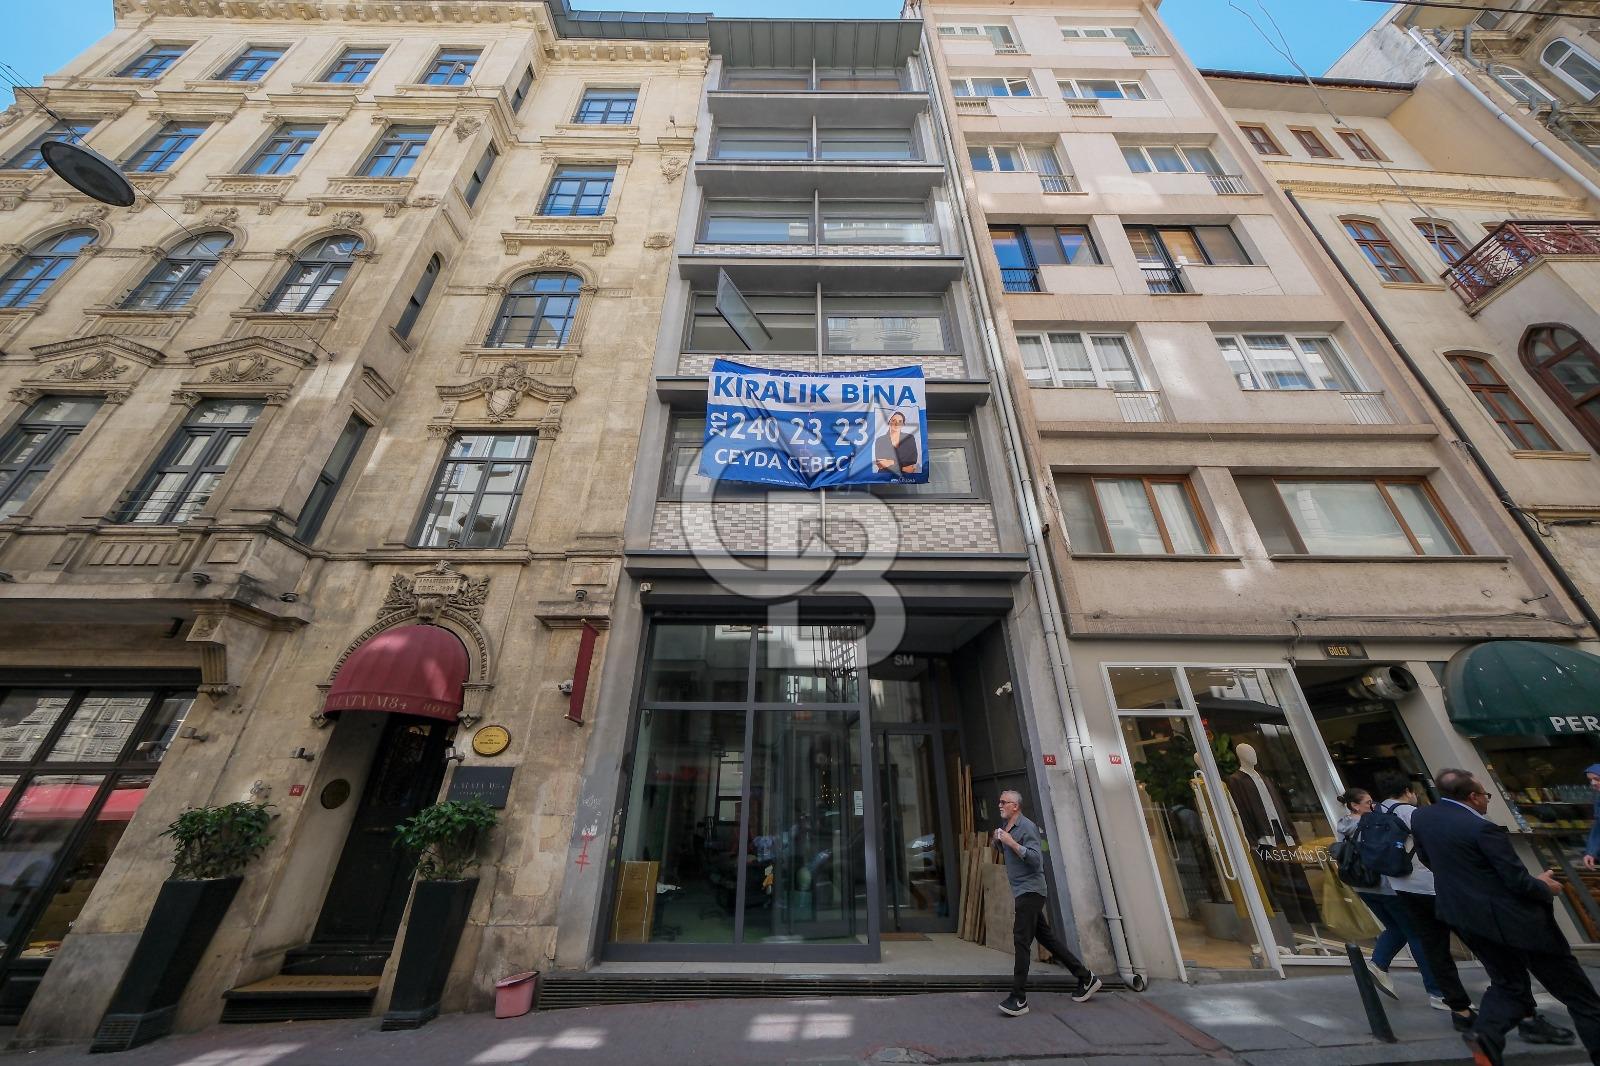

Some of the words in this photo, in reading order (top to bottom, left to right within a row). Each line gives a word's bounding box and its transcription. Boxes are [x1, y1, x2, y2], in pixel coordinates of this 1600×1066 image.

[713, 375, 830, 403] KIRALIK
[841, 379, 917, 406] BİNA
[709, 411, 728, 438] 212
[730, 412, 780, 443] 240
[790, 417, 822, 446] 23
[835, 417, 869, 446] 23
[714, 449, 782, 470] CEYDA
[1549, 716, 1600, 732] PER
